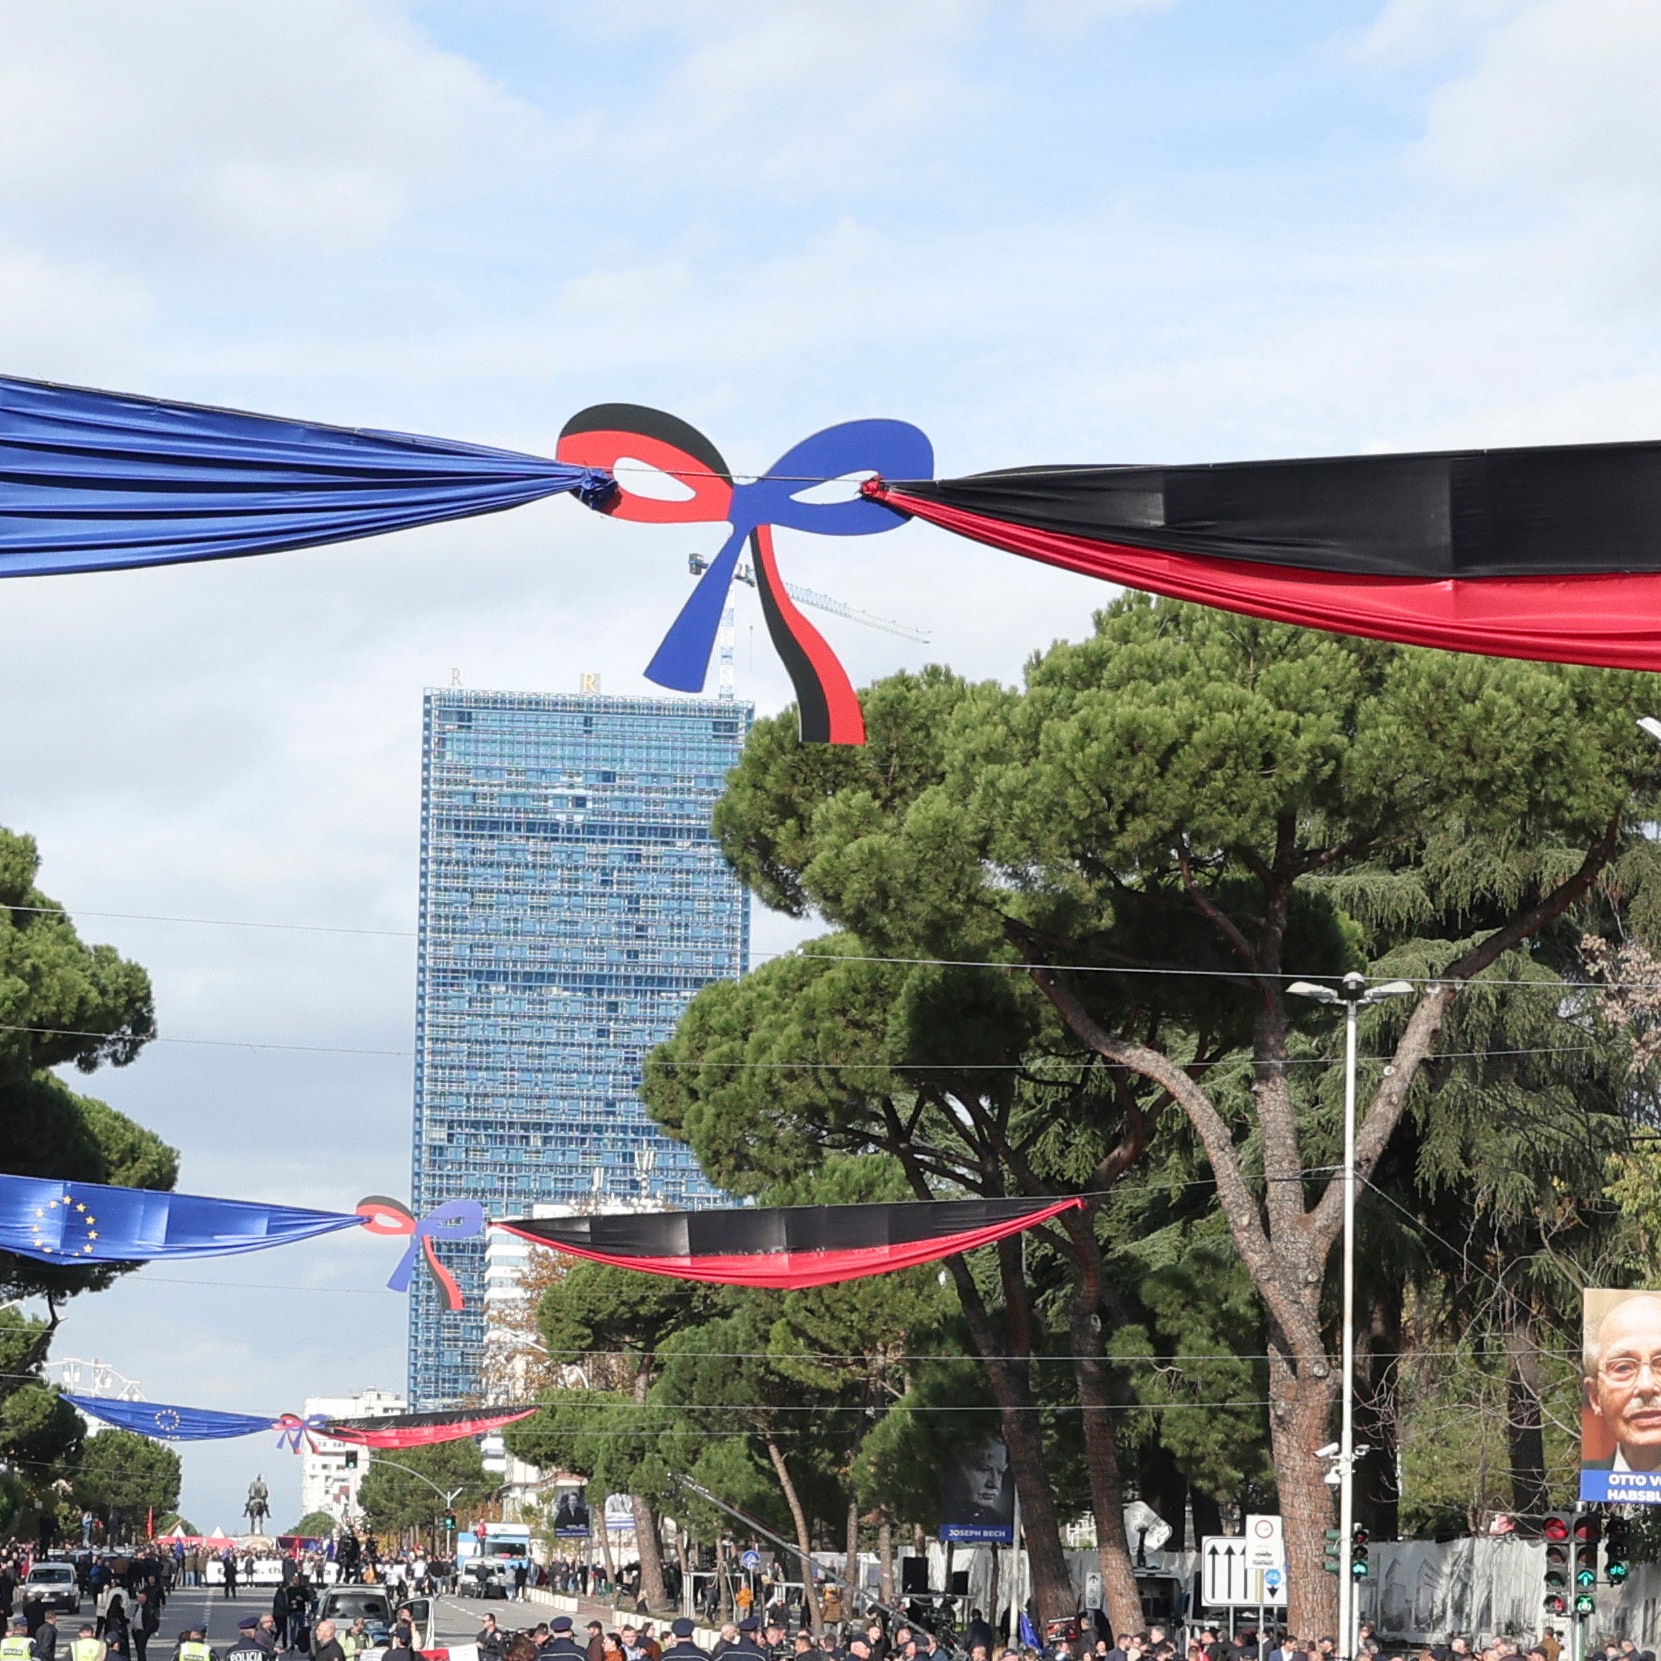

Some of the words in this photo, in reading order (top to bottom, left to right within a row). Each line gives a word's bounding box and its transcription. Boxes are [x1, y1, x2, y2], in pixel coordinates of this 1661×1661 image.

[450, 668, 464, 686] R
[583, 673, 599, 692] R
[1608, 1474, 1647, 1486] OTTO
[948, 1529, 981, 1538] JOSEPH
[982, 1530, 1006, 1538] BECH
